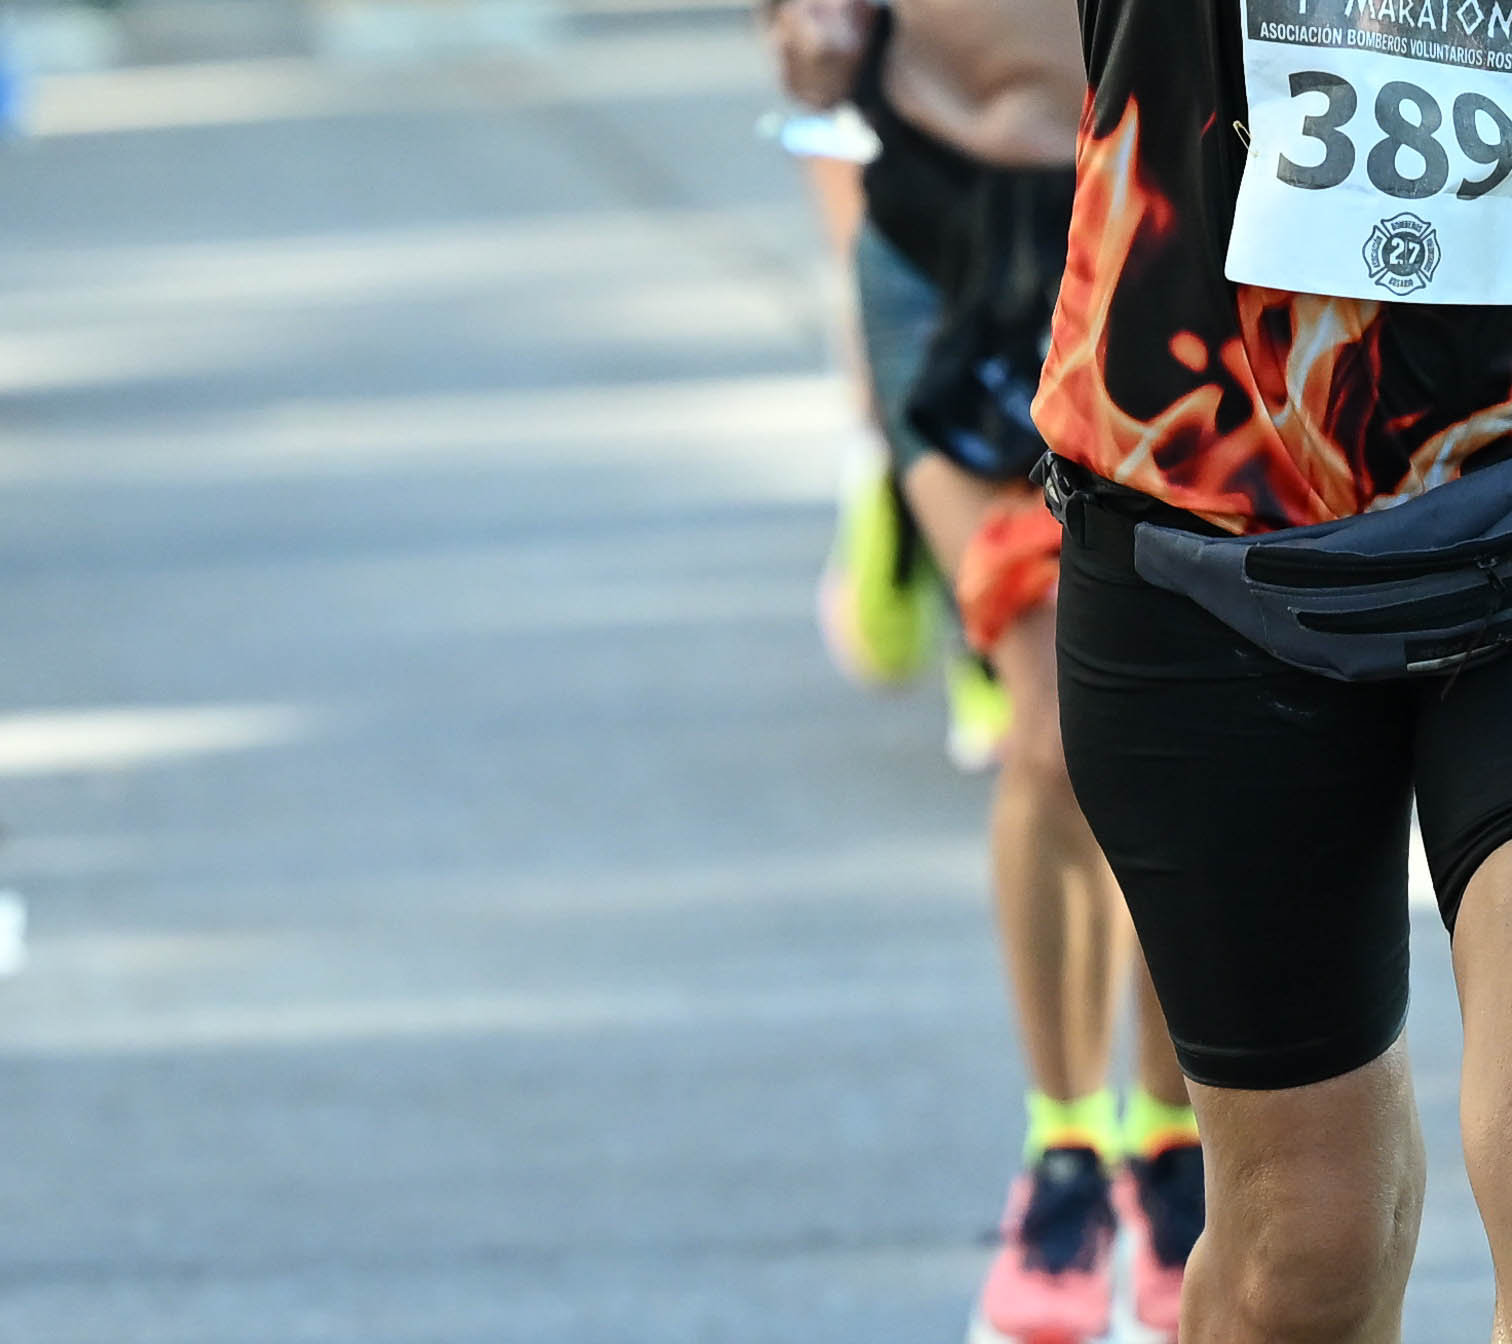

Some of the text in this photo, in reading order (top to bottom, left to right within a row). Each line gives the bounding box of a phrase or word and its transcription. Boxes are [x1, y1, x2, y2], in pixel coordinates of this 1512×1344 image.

[1259, 21, 1343, 46] ASOCIACIÓN
[1346, 28, 1408, 55] BOMBEROS
[1410, 38, 1483, 67] VOLUNTARIOS
[1390, 237, 1421, 264] 27
